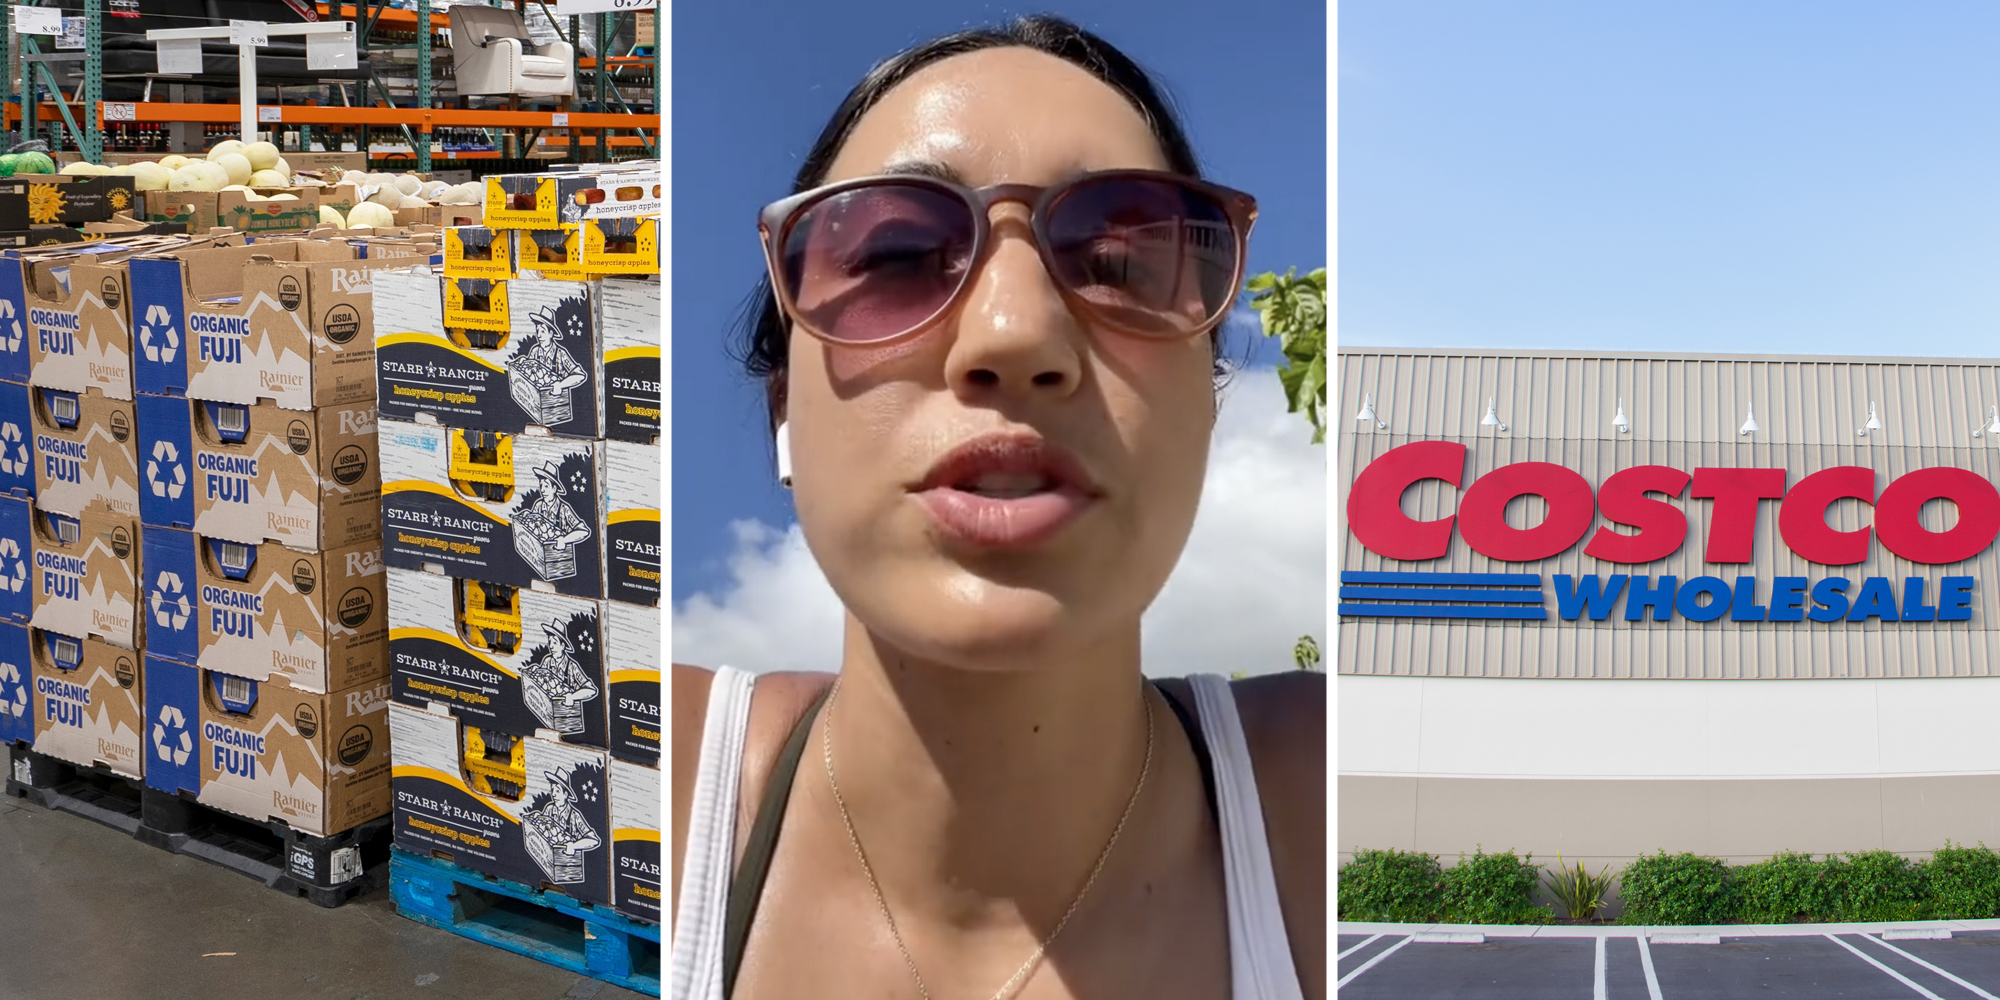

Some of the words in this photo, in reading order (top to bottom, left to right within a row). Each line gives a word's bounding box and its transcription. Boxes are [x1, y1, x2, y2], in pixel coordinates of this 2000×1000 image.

[596, 203, 637, 214] honeycrisp
[638, 201, 661, 211] apples
[490, 215, 527, 223] honeycrisp
[450, 264, 485, 273] honeycrisp
[485, 265, 505, 273] apples
[587, 259, 626, 268] honeycrisp
[627, 259, 651, 268] apples
[283, 284, 297, 293] USDA
[31, 309, 80, 331] ORGANIC
[190, 315, 250, 336] ORGANIC
[332, 313, 353, 323] USDA
[450, 315, 484, 324] honeycrisp
[330, 325, 355, 333] ORGANIC
[39, 328, 75, 356] FUJI
[200, 335, 242, 364] FUJI
[89, 360, 125, 379] Rainier
[383, 360, 424, 375] STARR
[260, 370, 304, 392] Rainier
[612, 377, 661, 393] STARR
[393, 384, 445, 402] honeycrisp
[444, 391, 477, 404] apples
[38, 435, 87, 460] ORGANIC
[46, 454, 80, 485] FUJI
[198, 453, 257, 477] ORGANIC
[340, 454, 360, 465] USDA
[337, 465, 362, 475] ORGANIC
[456, 467, 491, 477] honeycrisp
[207, 473, 249, 504] FUJI
[1347, 440, 2000, 566] COSTCO
[267, 511, 312, 531] Rainier
[388, 508, 429, 523] STARR
[398, 531, 449, 551] honeycrisp
[449, 541, 481, 554] apples
[37, 552, 87, 576] ORGANIC
[297, 567, 311, 576] USDA
[44, 571, 79, 601] FUJI
[203, 586, 262, 612] ORGANIC
[345, 596, 366, 608] USDA
[1552, 573, 1974, 623] WHOLESALE
[93, 609, 129, 630] Rainier
[342, 606, 368, 619] ORGANIC
[473, 614, 507, 626] honeycrisp
[212, 607, 254, 640] FUJI
[272, 649, 317, 671] Rainier
[396, 653, 438, 672] STARR
[38, 678, 91, 705] ORGANIC
[408, 677, 459, 700] honeycrisp
[458, 690, 490, 705] apples
[46, 697, 83, 729] FUJI
[299, 710, 313, 721] USDA
[619, 698, 661, 717] STAR
[98, 737, 135, 759] Rainier
[205, 723, 264, 754] ORGANIC
[345, 733, 365, 746] USDA
[343, 743, 369, 757] ORGANIC
[214, 745, 256, 780] FUJI
[364, 766, 378, 775] RAINIER
[273, 789, 317, 815] Rainier
[398, 791, 439, 811] STARR
[408, 816, 459, 841] honeycrisp
[459, 832, 490, 849] apples
[290, 851, 315, 870] iGPS
